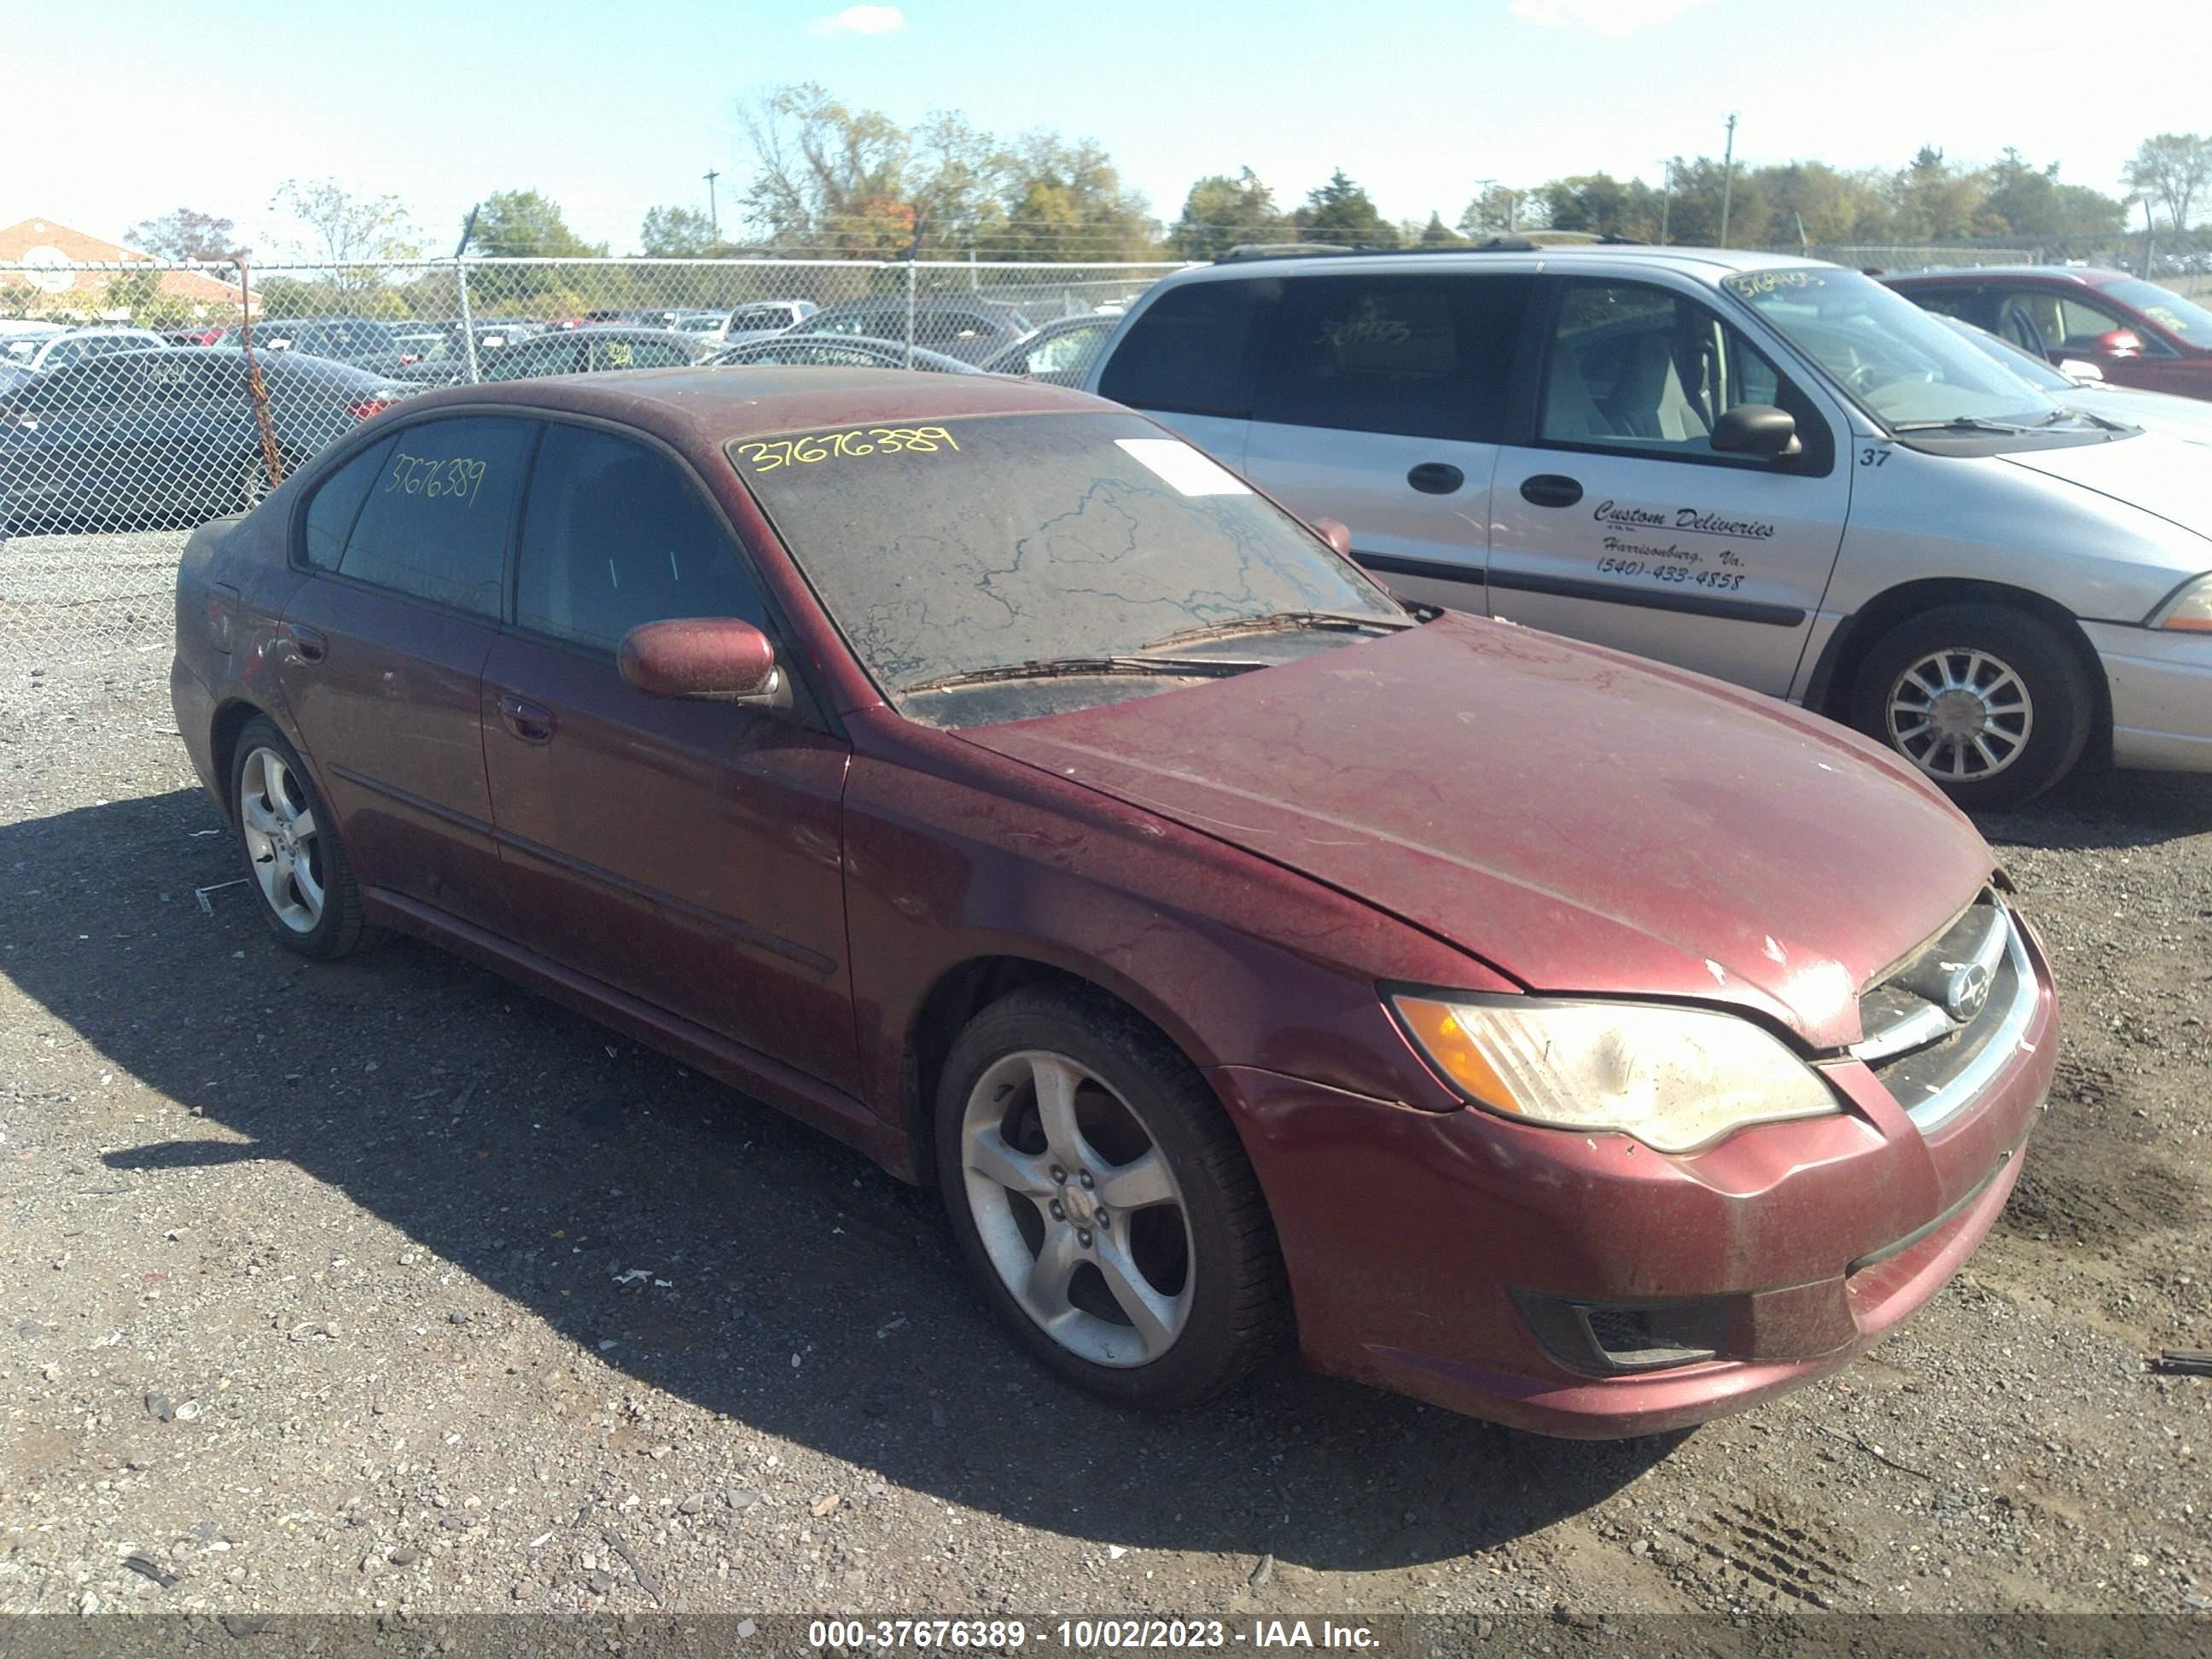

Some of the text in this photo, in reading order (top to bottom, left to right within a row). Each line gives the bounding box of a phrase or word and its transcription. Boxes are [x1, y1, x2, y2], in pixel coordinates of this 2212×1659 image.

[738, 427, 960, 472] 37676389
[1860, 448, 1892, 468] 37
[385, 453, 487, 508] 37676389
[1593, 500, 1775, 538] Custom Deliveries
[1597, 556, 1746, 591] (540)-433-4858
[1719, 550, 1746, 568] Va.
